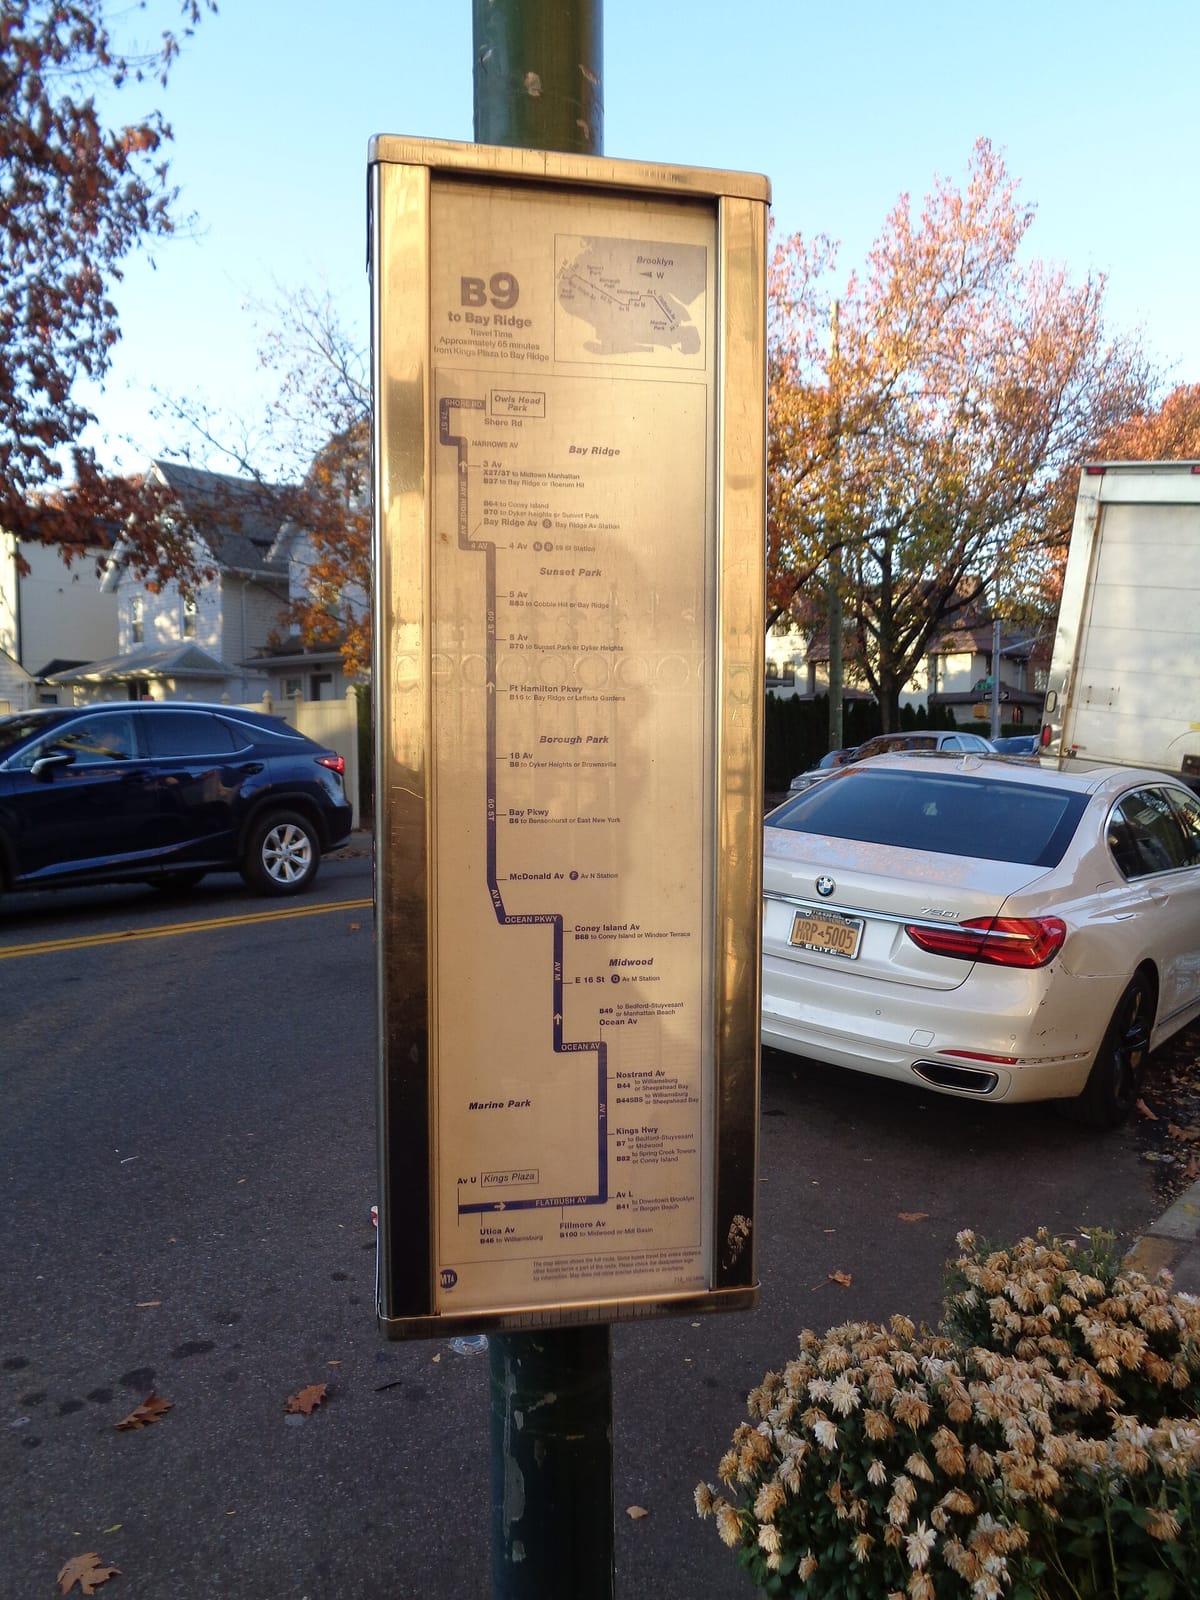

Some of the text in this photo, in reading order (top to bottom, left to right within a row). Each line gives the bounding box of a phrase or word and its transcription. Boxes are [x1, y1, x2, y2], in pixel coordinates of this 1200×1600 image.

[636, 256, 674, 266] Brooklyn
[460, 272, 520, 310] B9
[448, 311, 532, 328] to Bay Ridge
[469, 328, 512, 338] Travel Time
[440, 336, 496, 348] Approximately
[509, 342, 540, 350] minutes
[433, 346, 550, 362] from Kings Plaza Bay Ridge
[494, 395, 542, 405] Owls Head
[507, 404, 528, 412] Park
[484, 418, 522, 427] Shore Rd
[568, 446, 620, 456] Bay Ridge
[522, 480, 540, 488] Ridge
[483, 517, 499, 526] Bay
[501, 518, 525, 528] Ridge
[540, 567, 602, 576] Sunset Park
[520, 684, 558, 692] Hamilton
[560, 686, 583, 694] Pkwy
[539, 736, 609, 745] Borough Park
[488, 812, 494, 822] ST
[509, 808, 550, 817] Bay Pkwy
[510, 872, 552, 880] McDonald
[575, 924, 600, 933] Coney
[794, 920, 818, 942] HRP
[824, 926, 855, 950] 5005
[805, 944, 838, 955] ELITE
[554, 961, 560, 972] AV
[608, 958, 654, 967] Midwood
[561, 1043, 588, 1051] OCEAN
[468, 1098, 532, 1110] Marine Park
[600, 1103, 606, 1113] AV
[484, 1174, 508, 1184] Kings
[511, 1172, 535, 1180] Plaza
[536, 1198, 575, 1206] FLATBUSH
[560, 1222, 593, 1230] Fillmore
